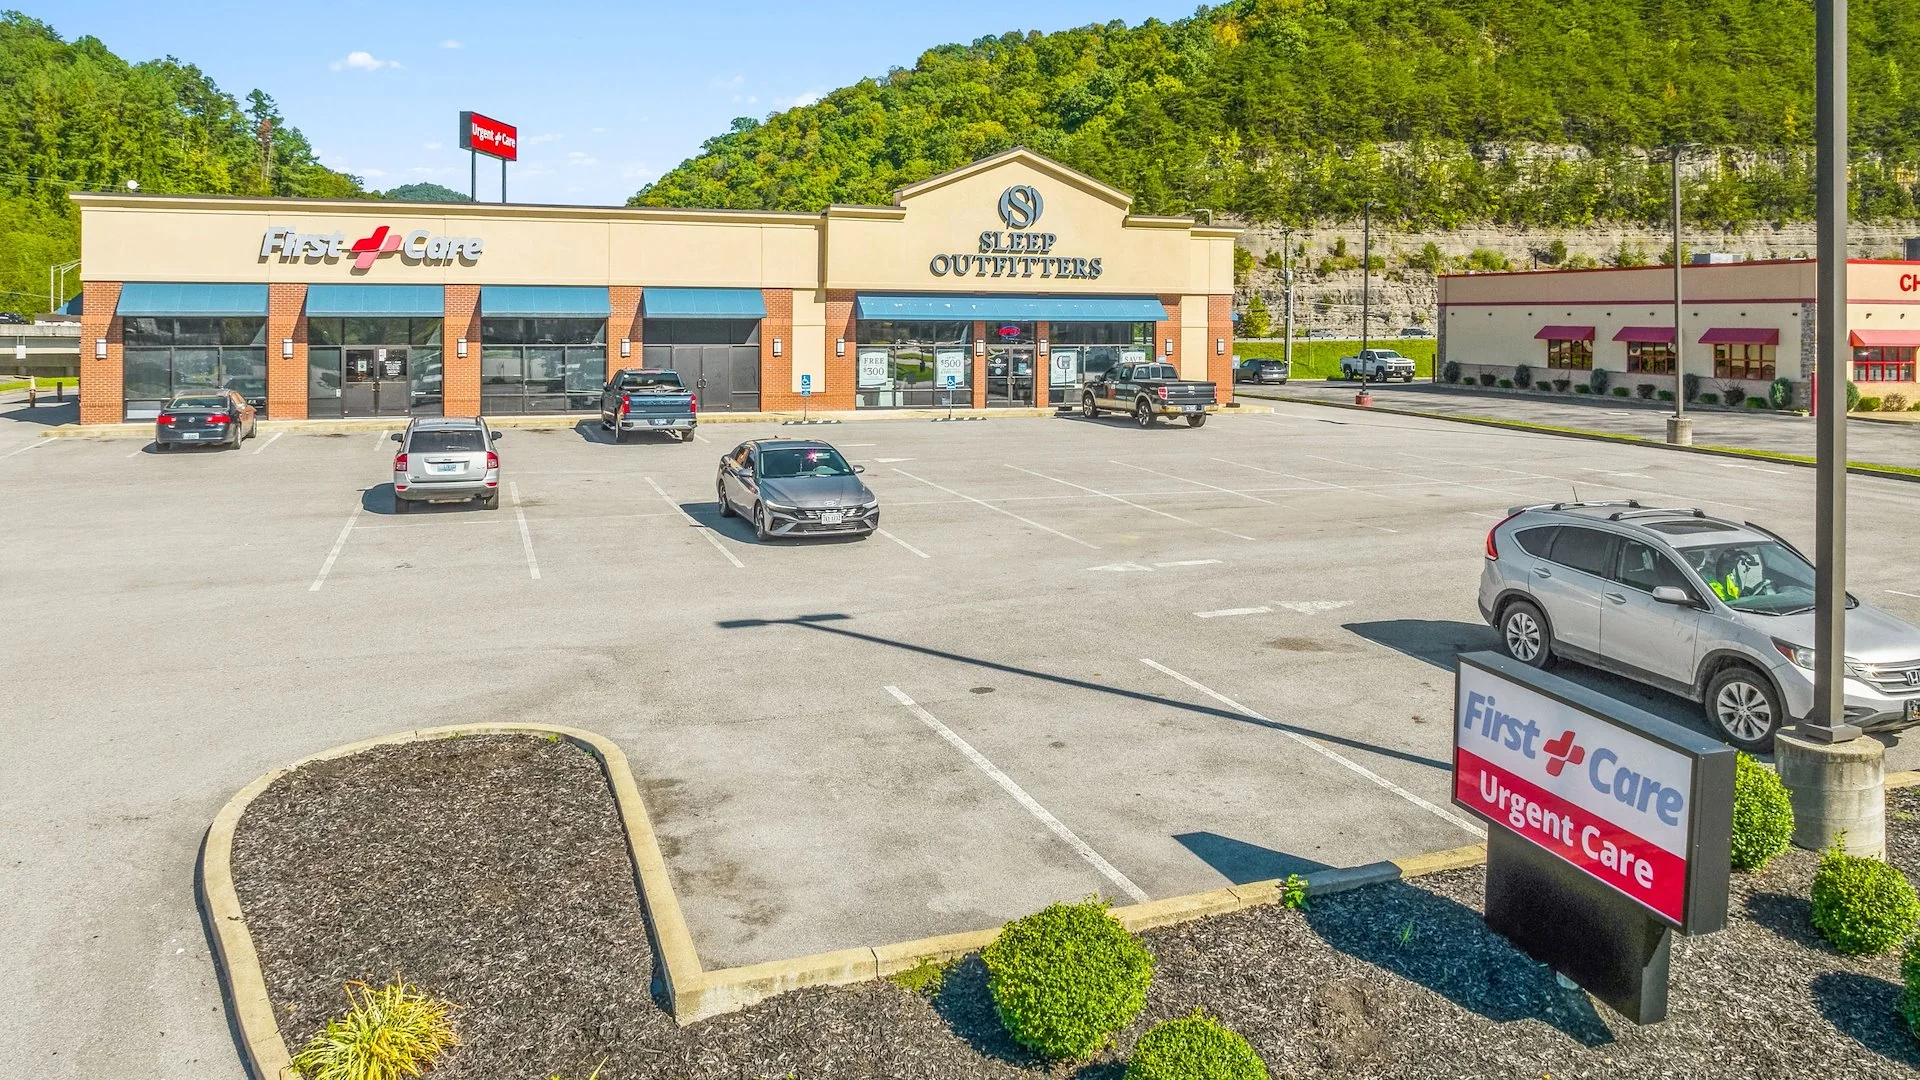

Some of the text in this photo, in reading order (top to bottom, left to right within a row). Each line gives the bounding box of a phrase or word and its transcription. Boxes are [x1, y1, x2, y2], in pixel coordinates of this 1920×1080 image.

[472, 122, 515, 148] Urgent Care
[260, 226, 484, 263] First Care
[979, 230, 1057, 253] SLEEP
[930, 253, 1103, 279] OUTFITTERS
[1900, 274, 1920, 292] CH
[998, 328, 1020, 336] OPEN
[863, 357, 885, 365] FREE
[863, 367, 885, 376] $300
[940, 359, 962, 368] $500
[1463, 690, 1684, 827] First Care
[1480, 770, 1653, 889] Urgent Care
